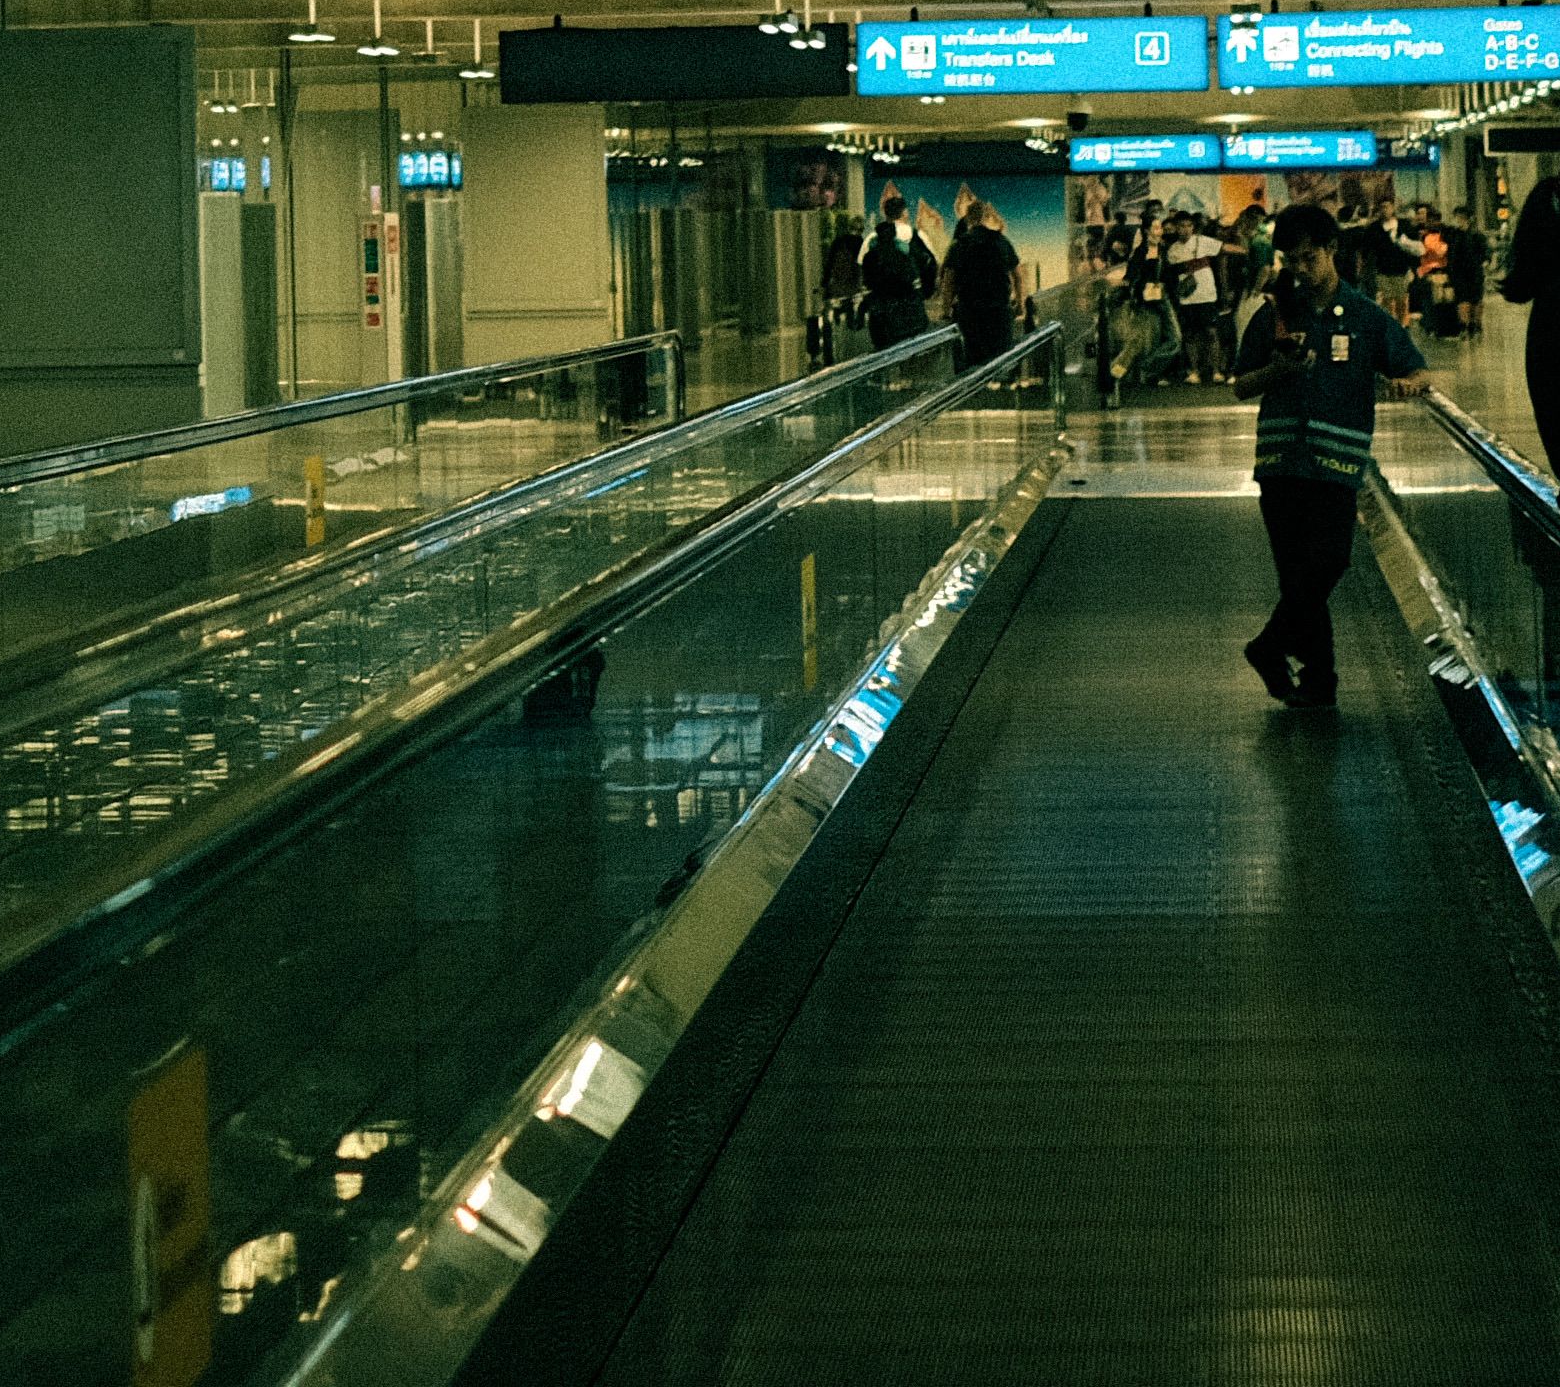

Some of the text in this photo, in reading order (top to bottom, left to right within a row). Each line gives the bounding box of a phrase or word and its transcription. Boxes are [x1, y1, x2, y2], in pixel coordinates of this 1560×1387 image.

[1142, 36, 1161, 60] 4
[1306, 40, 1444, 60] Connecting Flights
[1484, 34, 1540, 51] A-B-C
[944, 50, 1055, 67] Transfers Desk
[1484, 52, 1560, 70] D-E-F-G
